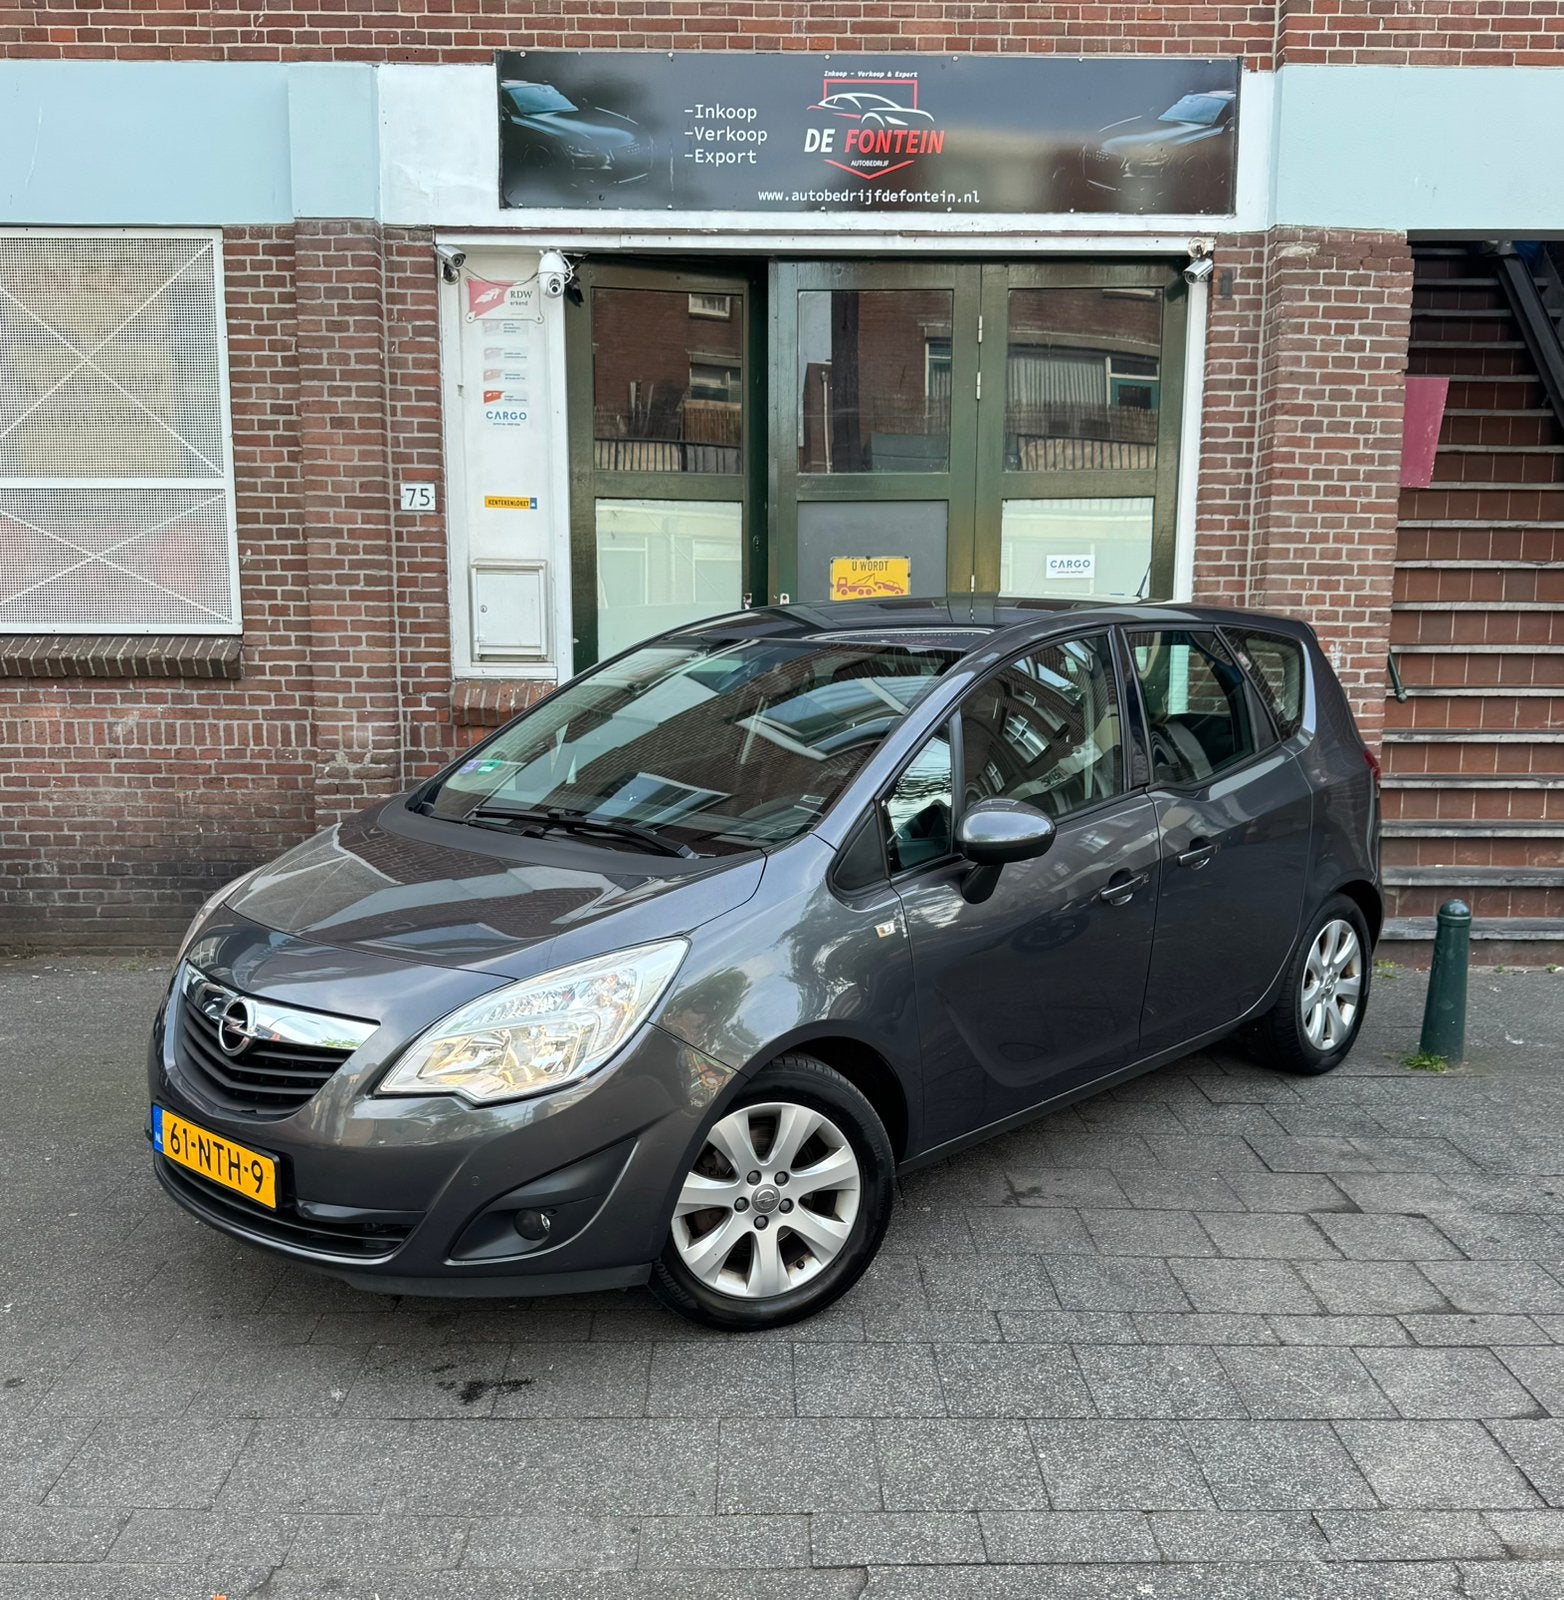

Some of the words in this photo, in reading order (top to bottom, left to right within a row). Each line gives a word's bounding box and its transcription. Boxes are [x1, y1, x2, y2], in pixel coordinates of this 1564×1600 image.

[823, 70, 847, 78] Inkoop
[857, 70, 885, 79] Verkoop
[894, 71, 918, 79] Export
[803, 128, 836, 153] DE
[844, 129, 945, 154] FONTEIN
[850, 159, 889, 168] AUTOBEDRIJF
[757, 189, 980, 205] www.autobedrijfdefontein.nl
[510, 290, 533, 299] RDW
[485, 410, 527, 421] CARGO
[405, 488, 430, 507] 75
[851, 560, 858, 572] U
[860, 560, 889, 572] WORDT
[1050, 559, 1091, 569] CARGO
[154, 1131, 163, 1145] NL
[170, 1122, 264, 1194] 61-NTH-9
